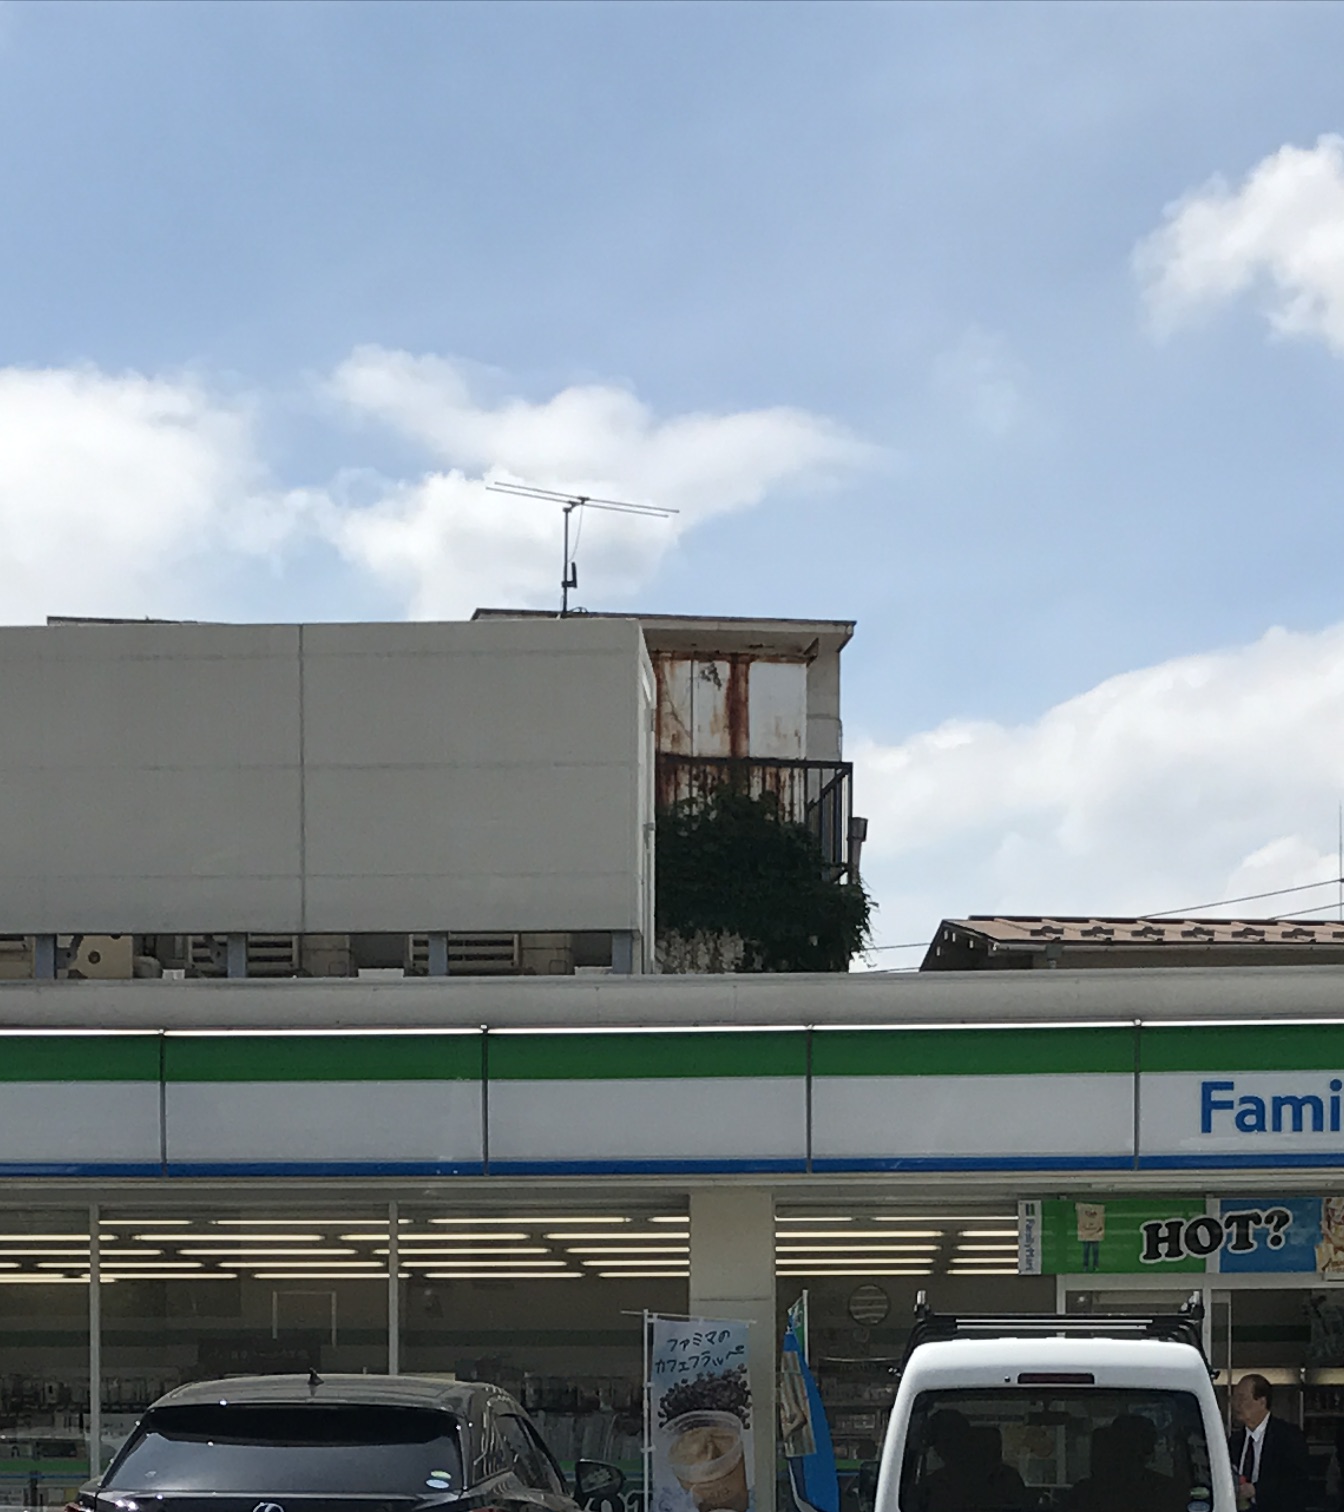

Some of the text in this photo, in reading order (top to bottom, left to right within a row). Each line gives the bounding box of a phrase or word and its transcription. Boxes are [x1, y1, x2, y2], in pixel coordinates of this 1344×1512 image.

[1140, 1206, 1293, 1263] HOT?
[667, 1329, 730, 1352] ファミマの
